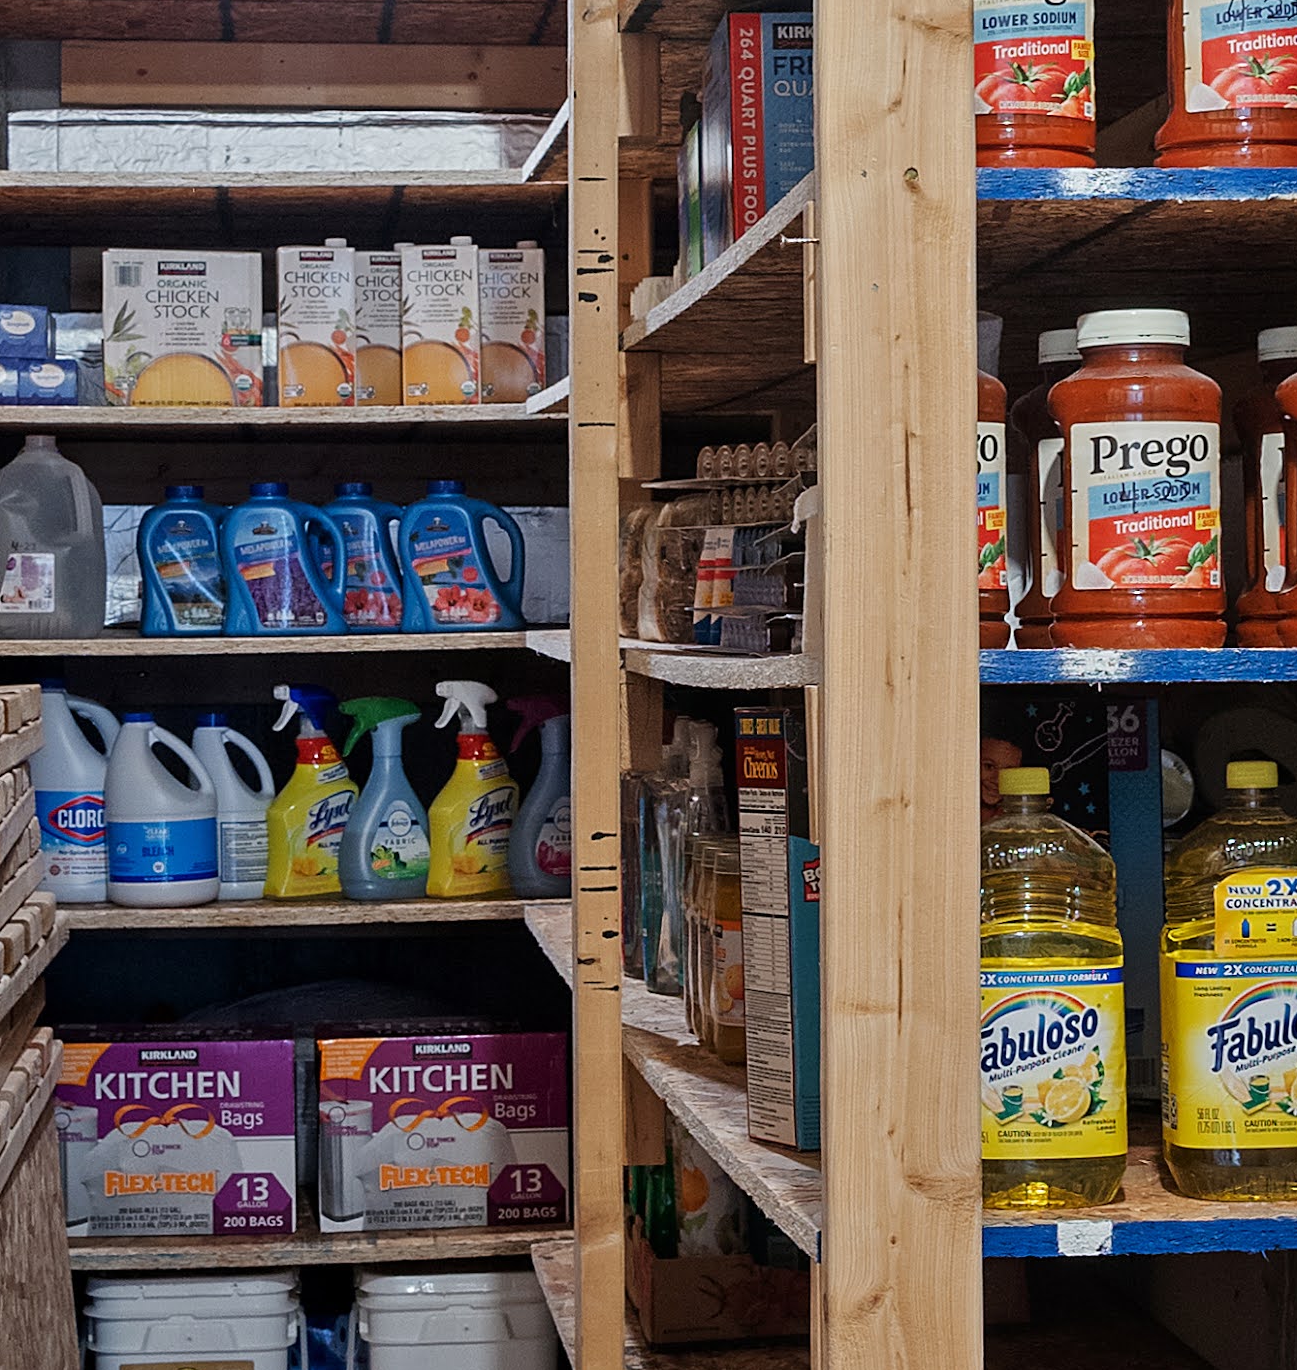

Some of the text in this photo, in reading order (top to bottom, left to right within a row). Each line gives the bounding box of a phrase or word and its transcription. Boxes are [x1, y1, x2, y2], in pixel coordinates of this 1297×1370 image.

[982, 11, 1077, 30] LOWER SODIUM
[778, 26, 813, 39] KIRK
[740, 28, 754, 60] 264
[992, 39, 1069, 59] Traditional
[737, 67, 755, 129] QUART
[742, 135, 757, 179] PLUS
[160, 262, 206, 271] KIRKLAND
[407, 270, 472, 282] CHICKEN
[157, 280, 207, 289] ORGANIC
[284, 271, 350, 284] CHICKEN
[355, 275, 400, 287] CHICK
[145, 290, 220, 304] CHICKEN
[291, 286, 342, 298] STOCK
[363, 289, 401, 301] STOC
[415, 284, 465, 296] STOCK
[482, 287, 531, 298] STOCK
[154, 304, 211, 319] STOCK
[1090, 434, 1209, 478] Prego
[1114, 511, 1193, 535] Traditional
[743, 756, 779, 780] Cheerios
[57, 809, 105, 828] CLORO
[308, 794, 354, 830] Lysol
[469, 790, 514, 828] Lysol
[385, 837, 416, 845] FABRIC
[141, 845, 174, 858] BLEACH
[1228, 886, 1261, 895] NEW
[998, 973, 1065, 984] CONCENTRATED
[1067, 971, 1107, 983] FORMULA
[1195, 965, 1218, 975] NEW
[1223, 964, 1243, 976] 2X
[415, 1044, 471, 1055] KIRKLAND
[981, 1008, 1098, 1073] abuloso
[141, 1049, 197, 1060] KIRKLAND
[988, 1043, 1086, 1083] Multi-Purpose Cleaner
[1235, 1044, 1296, 1074] Multi-Purpose
[94, 1071, 241, 1100] KITCHEN
[369, 1063, 513, 1094] KITCHEN
[221, 1110, 264, 1129] Bags
[494, 1102, 537, 1121] Bags
[105, 1170, 217, 1196] FLEX-TECH
[379, 1163, 490, 1191] FLEX-TECH
[510, 1168, 542, 1192] 13
[235, 1177, 269, 1201] 13
[223, 1216, 246, 1227] 200
[249, 1215, 284, 1227] BAGS
[498, 1208, 520, 1219] 200
[523, 1207, 557, 1219] BAGS
